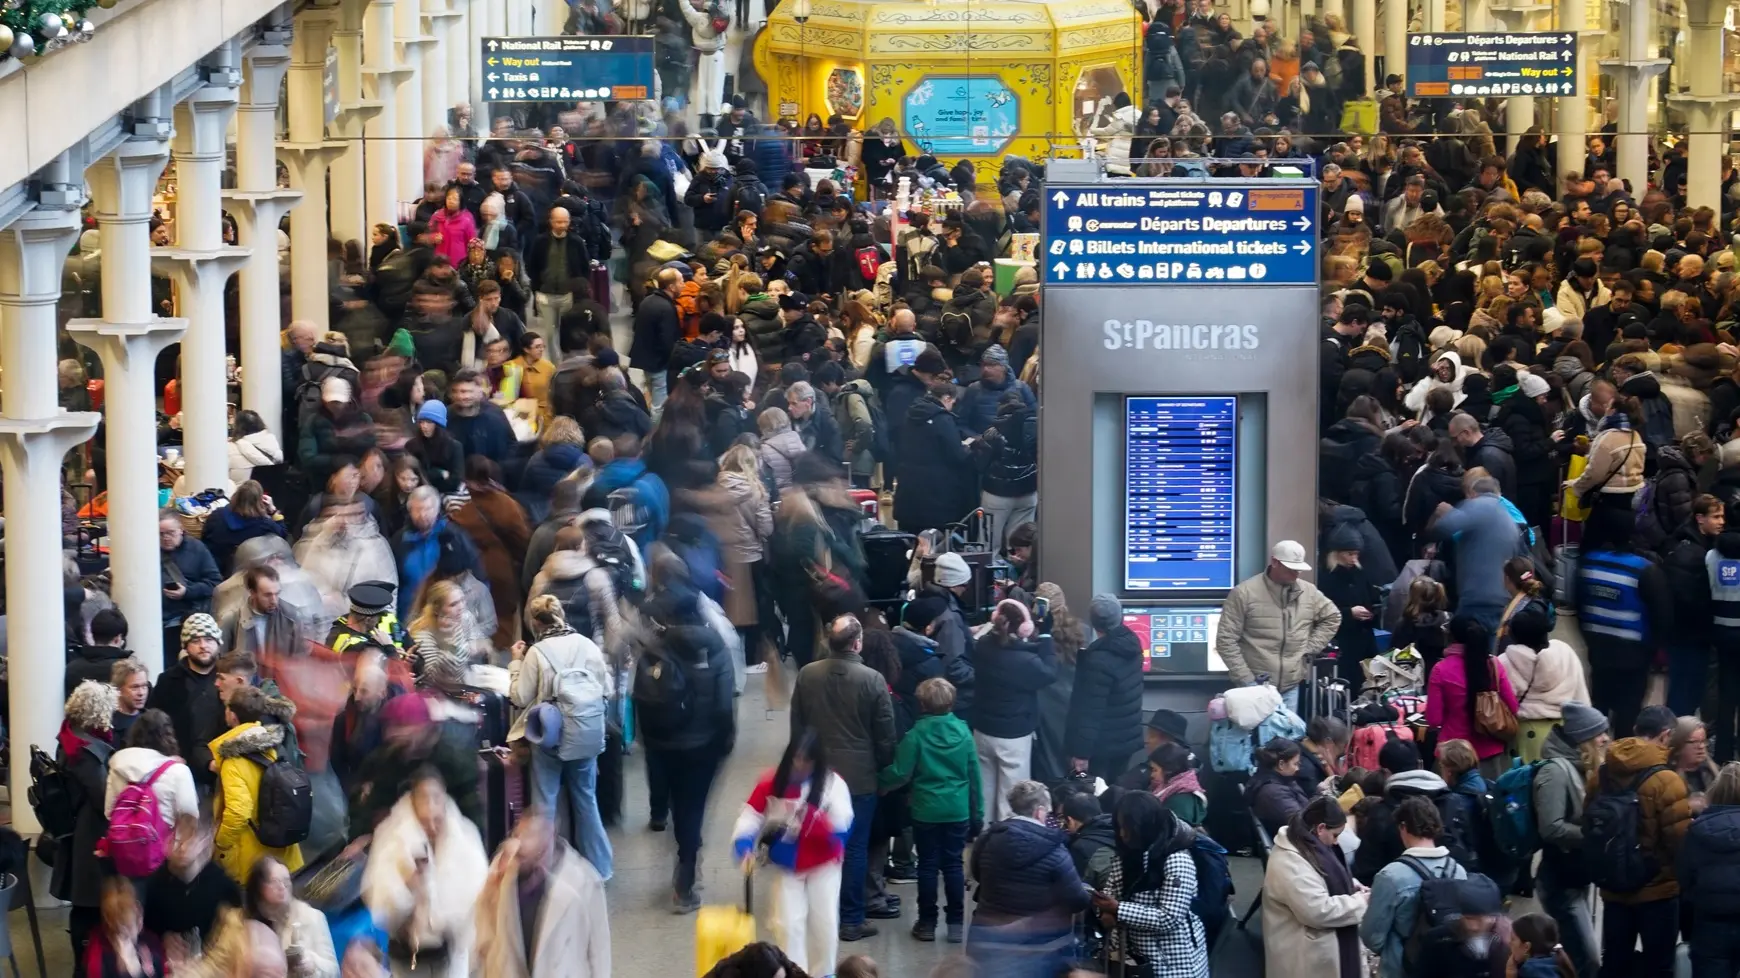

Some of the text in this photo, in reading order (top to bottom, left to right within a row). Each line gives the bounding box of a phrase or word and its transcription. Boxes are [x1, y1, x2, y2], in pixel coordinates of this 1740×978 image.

[501, 40, 562, 51] National Rail
[1467, 35, 1558, 47] Départs Departures
[1498, 51, 1558, 61] National Rail
[503, 57, 540, 68] Way out
[503, 72, 529, 82] Taxis
[1521, 67, 1558, 78] Way out
[1076, 193, 1146, 207] All trains
[1140, 216, 1287, 234] Départs Departures
[1086, 240, 1288, 254] Billets International tickets
